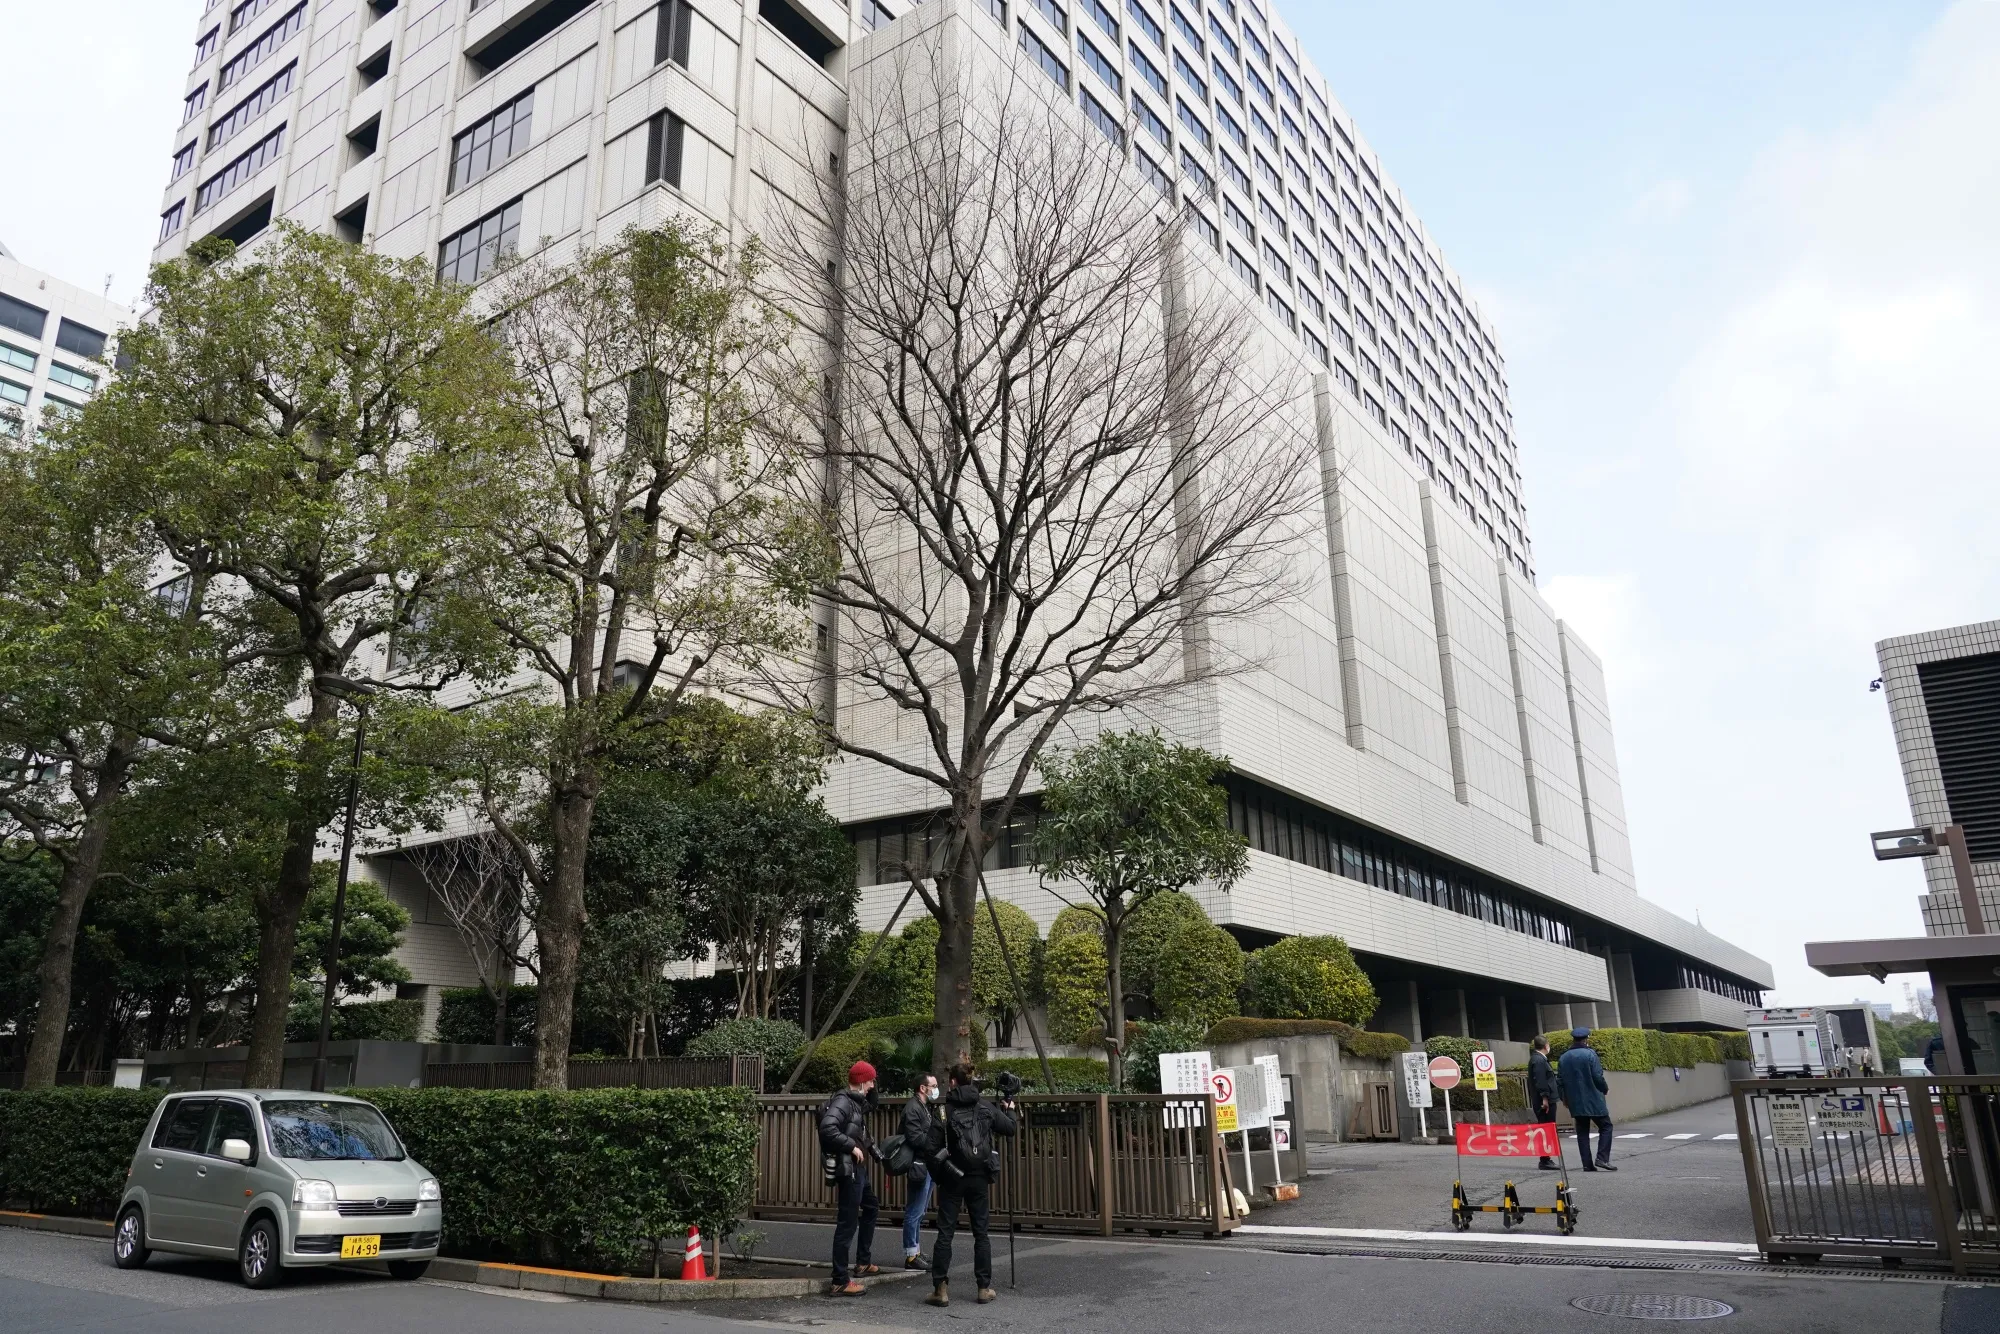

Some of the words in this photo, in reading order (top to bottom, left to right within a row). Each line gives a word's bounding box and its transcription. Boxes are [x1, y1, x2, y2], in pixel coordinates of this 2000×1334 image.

[1479, 1058, 1489, 1068] 10
[1846, 1099, 1860, 1110] P
[1817, 1111, 1863, 1119] 警備員がご案内します
[1466, 1125, 1552, 1156] とまれ
[351, 1244, 378, 1256] 14-99
